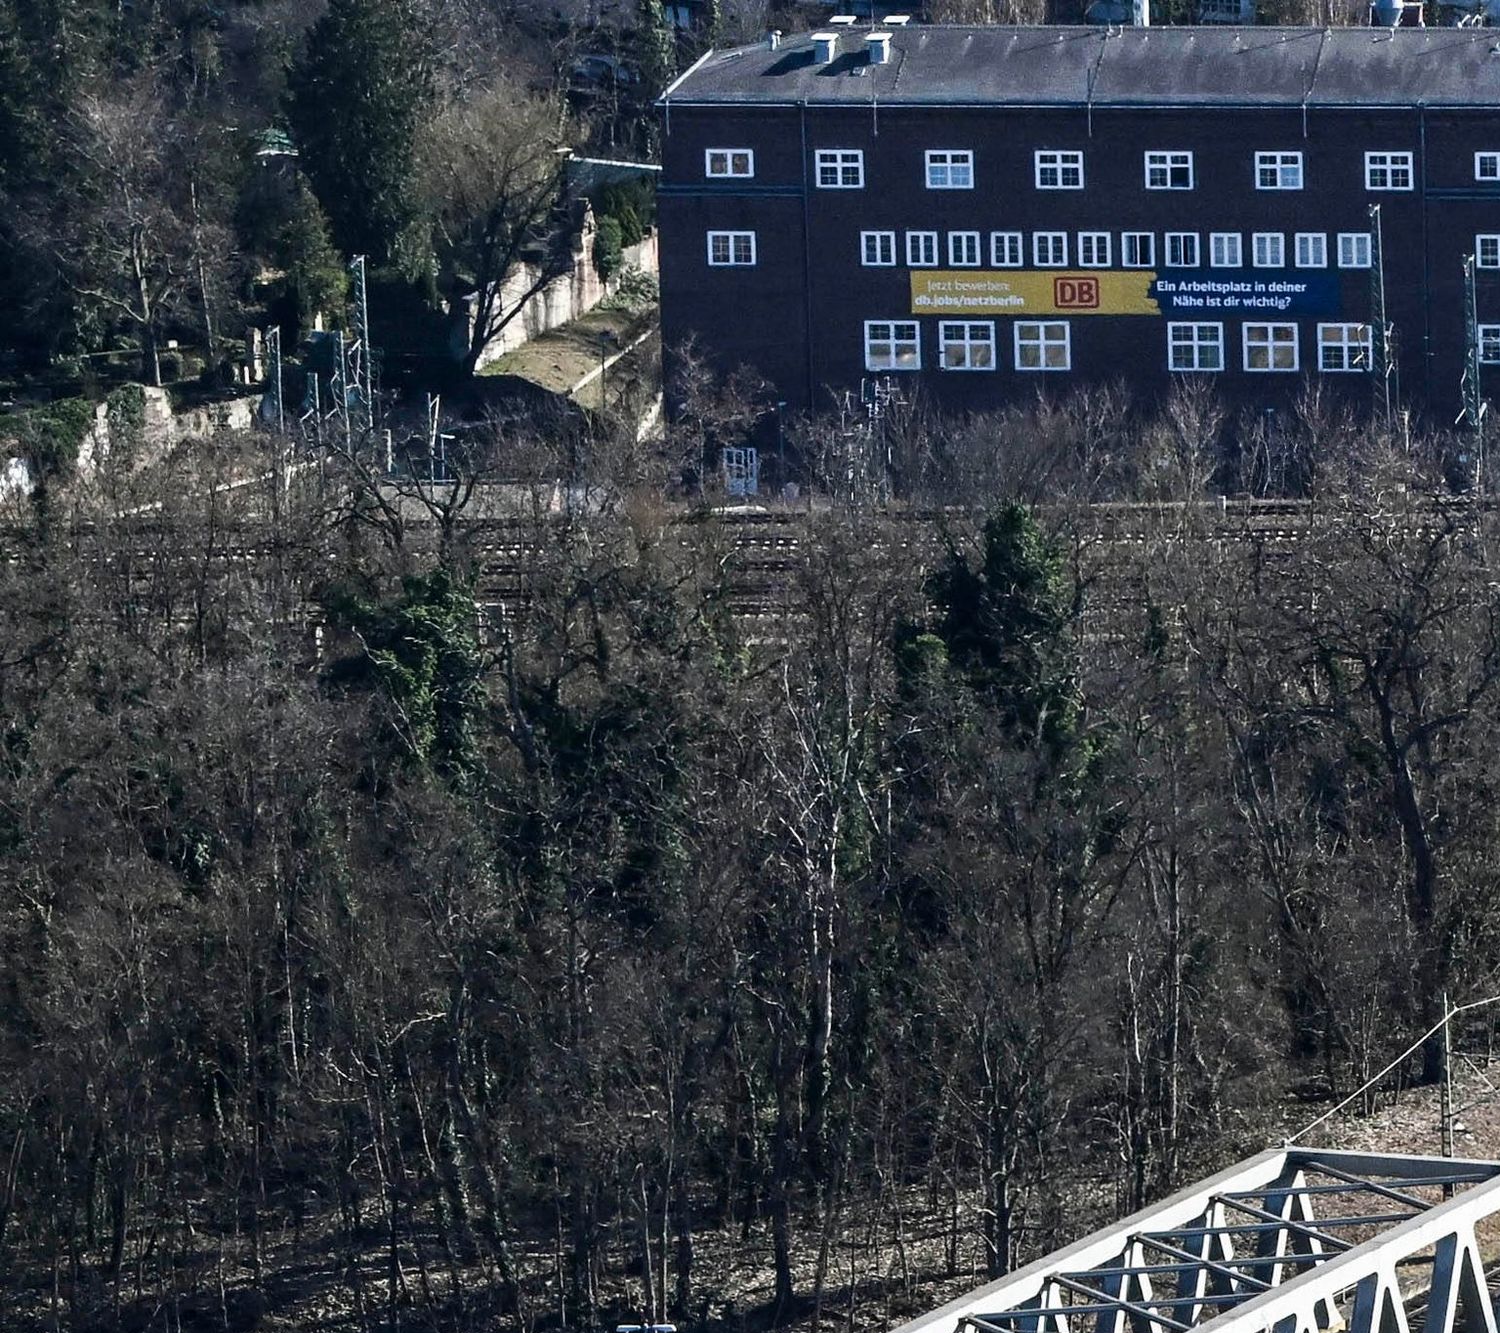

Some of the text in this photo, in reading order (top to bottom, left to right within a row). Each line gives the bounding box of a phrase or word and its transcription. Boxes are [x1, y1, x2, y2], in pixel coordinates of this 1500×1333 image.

[927, 280, 951, 292] Jetzt
[1156, 281, 1307, 294] Ein Arbeitsplatz in deiner
[1058, 282, 1094, 304] DB
[914, 294, 1024, 307] db.jobs/netzberlin
[1172, 296, 1292, 310] Nähe ist dir wichtig?
